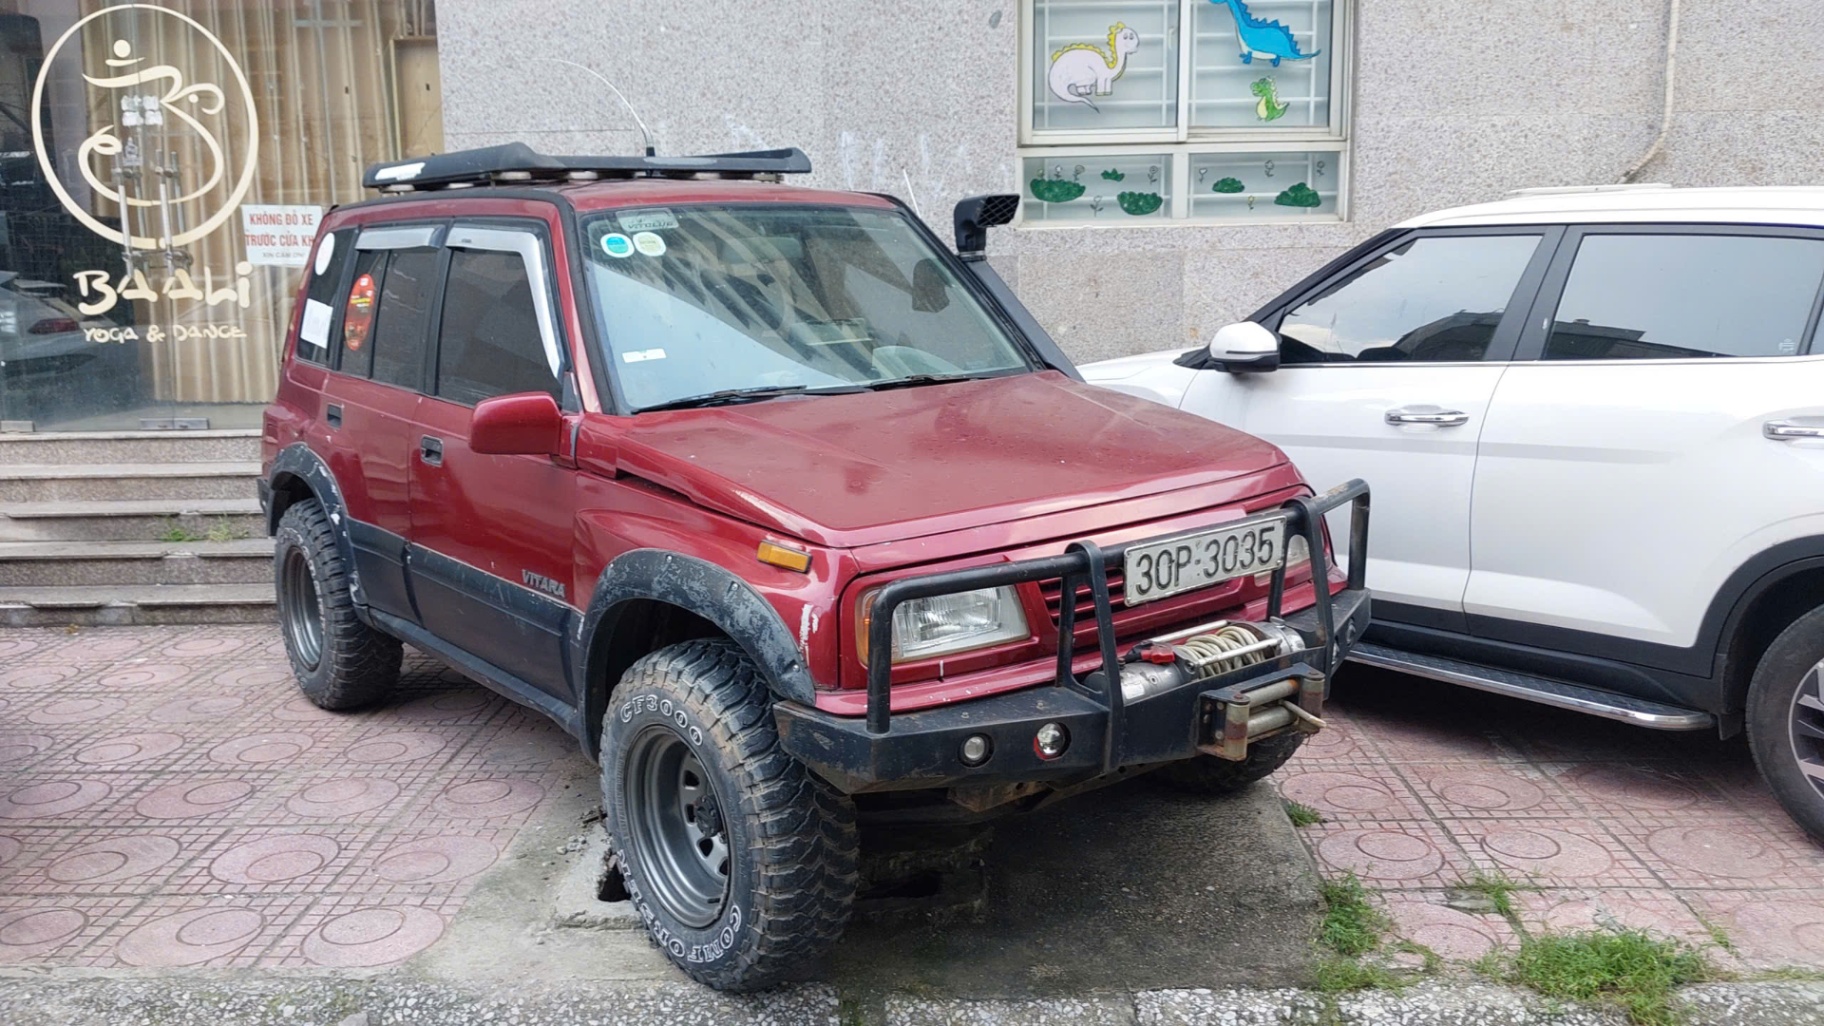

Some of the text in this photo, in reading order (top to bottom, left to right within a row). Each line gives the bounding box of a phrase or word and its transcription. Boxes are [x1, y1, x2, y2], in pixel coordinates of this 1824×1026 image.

[301, 213, 314, 226] XE
[84, 324, 248, 344] YOGA & DANCE
[522, 568, 566, 598] VITARA
[620, 694, 703, 746] CF3000
